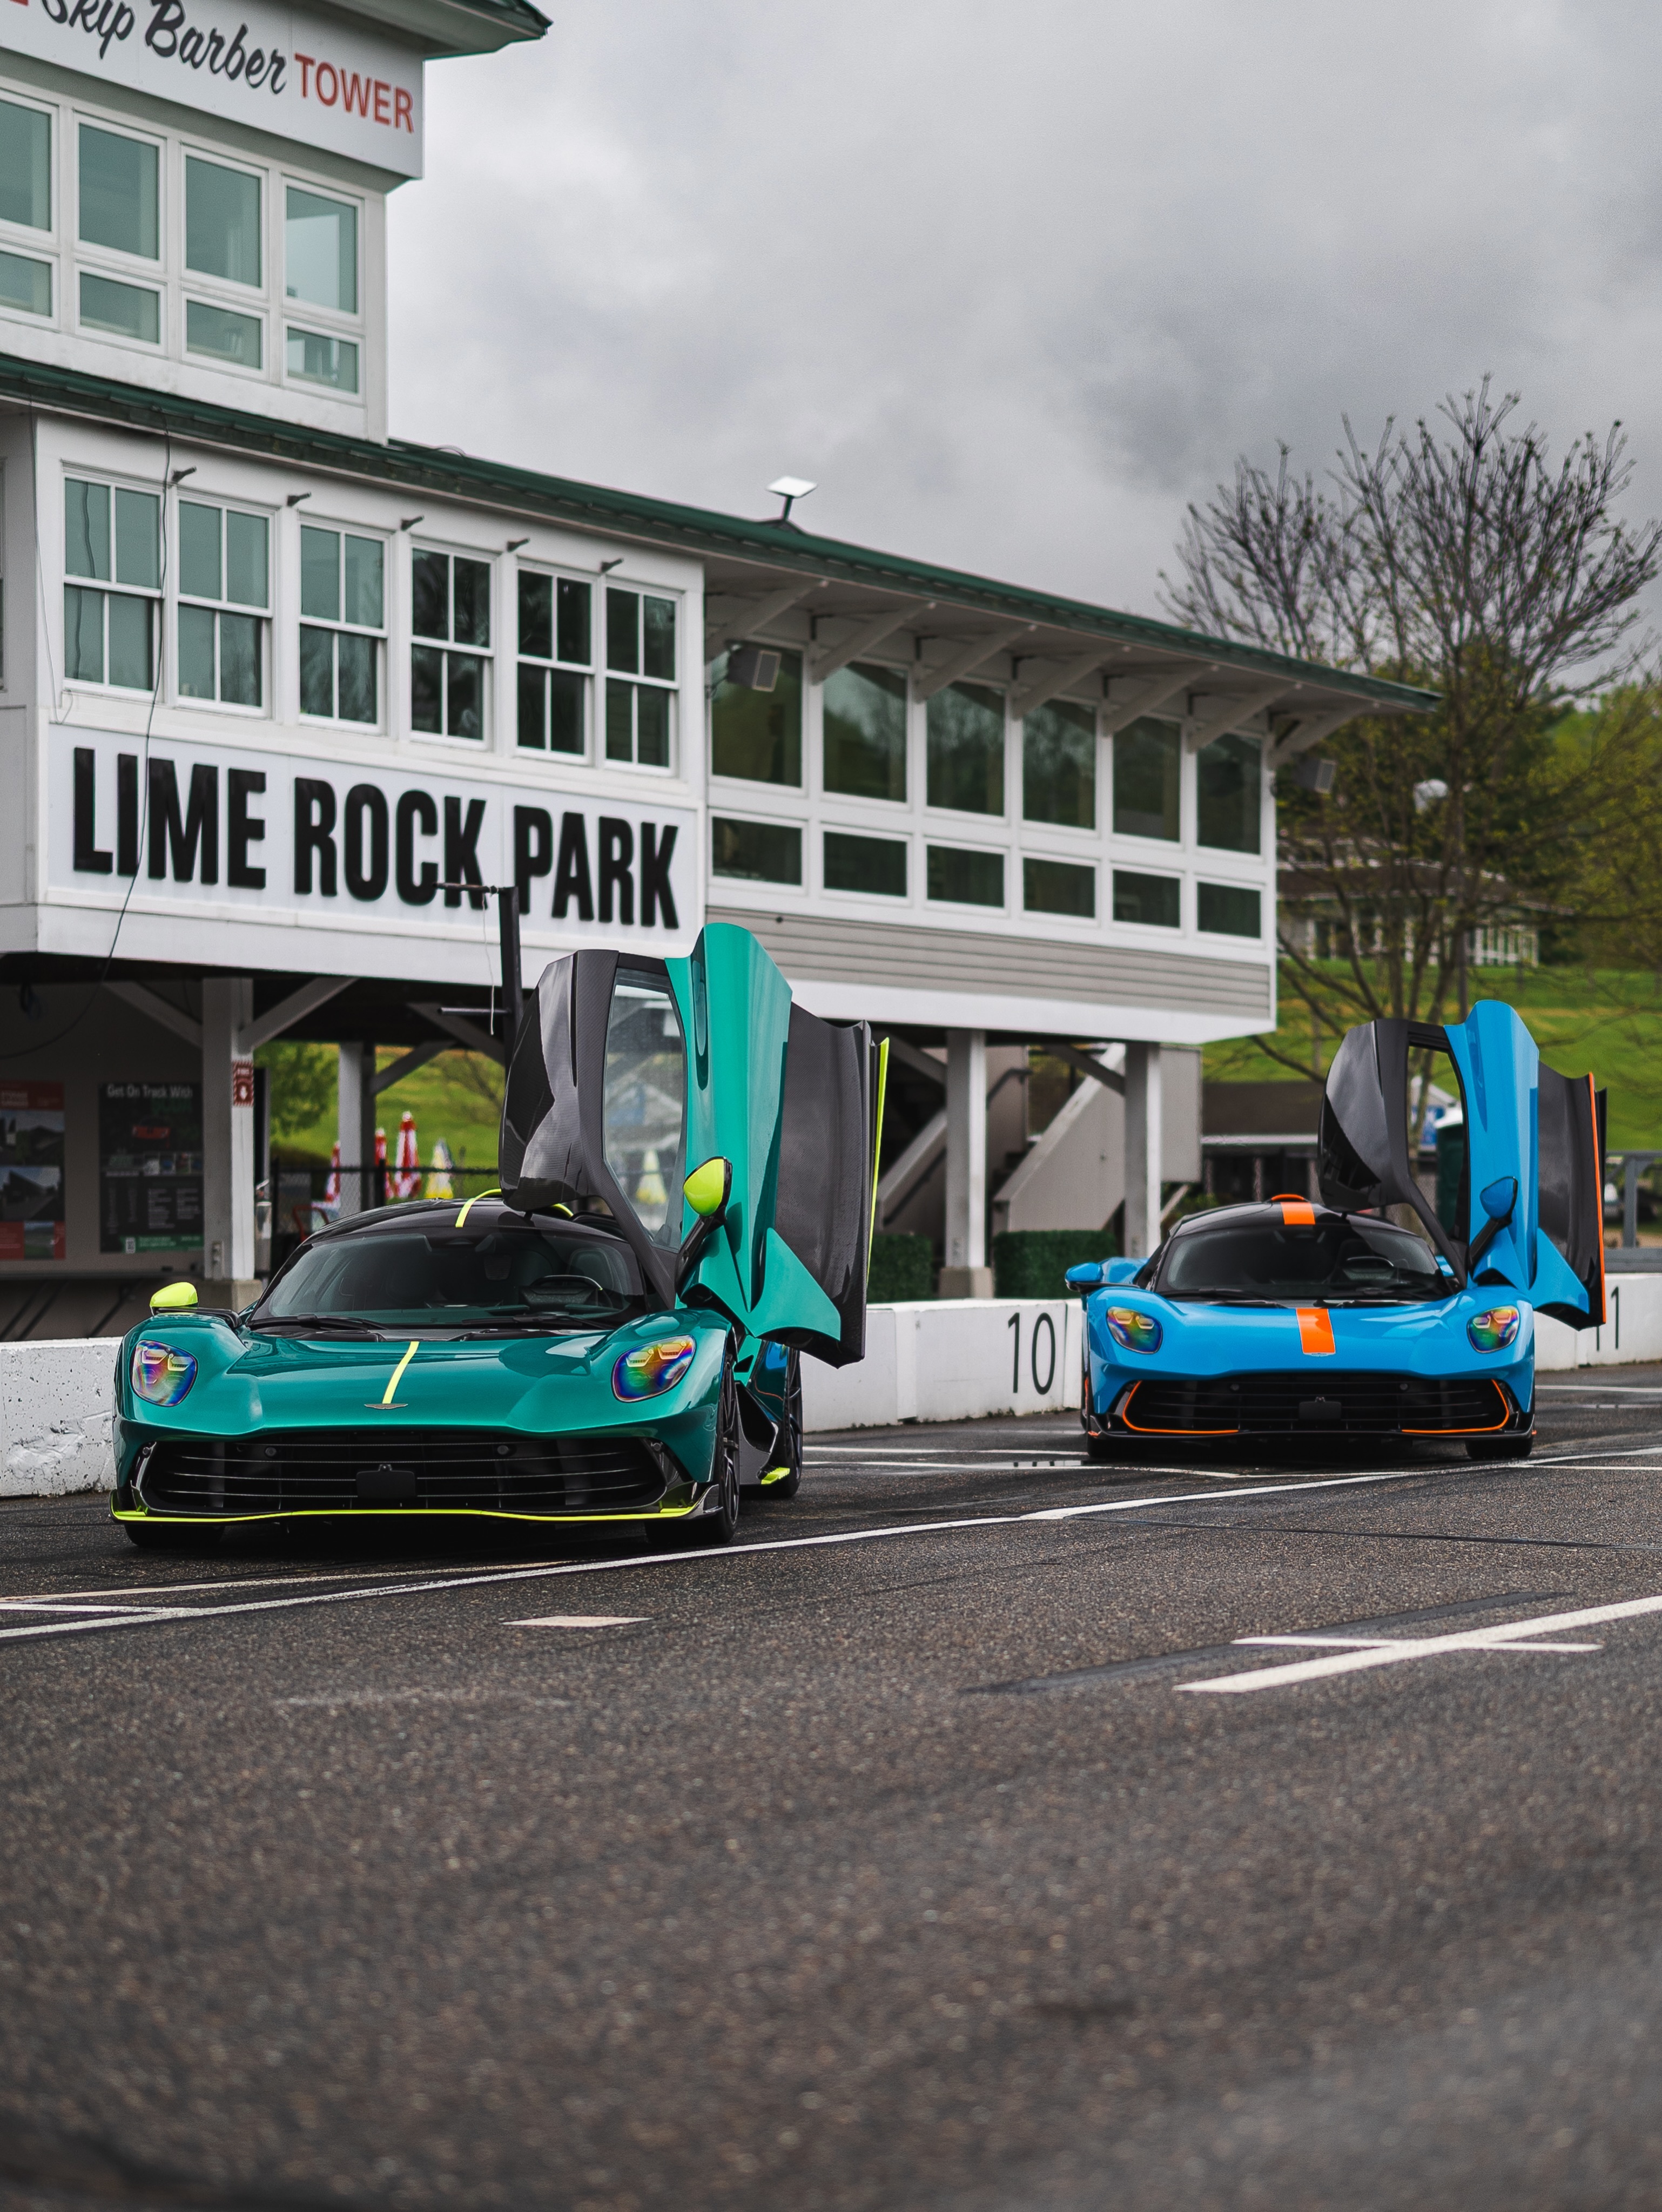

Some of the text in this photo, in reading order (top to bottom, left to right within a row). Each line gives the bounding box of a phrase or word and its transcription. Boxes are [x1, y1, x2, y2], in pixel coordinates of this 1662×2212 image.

[145, 0, 286, 95] Barber
[294, 52, 414, 133] TOWER
[74, 746, 679, 929] LIME ROCK PARK
[107, 1084, 124, 1098] Get
[127, 1084, 140, 1098] On
[1008, 1312, 1055, 1395] 10
